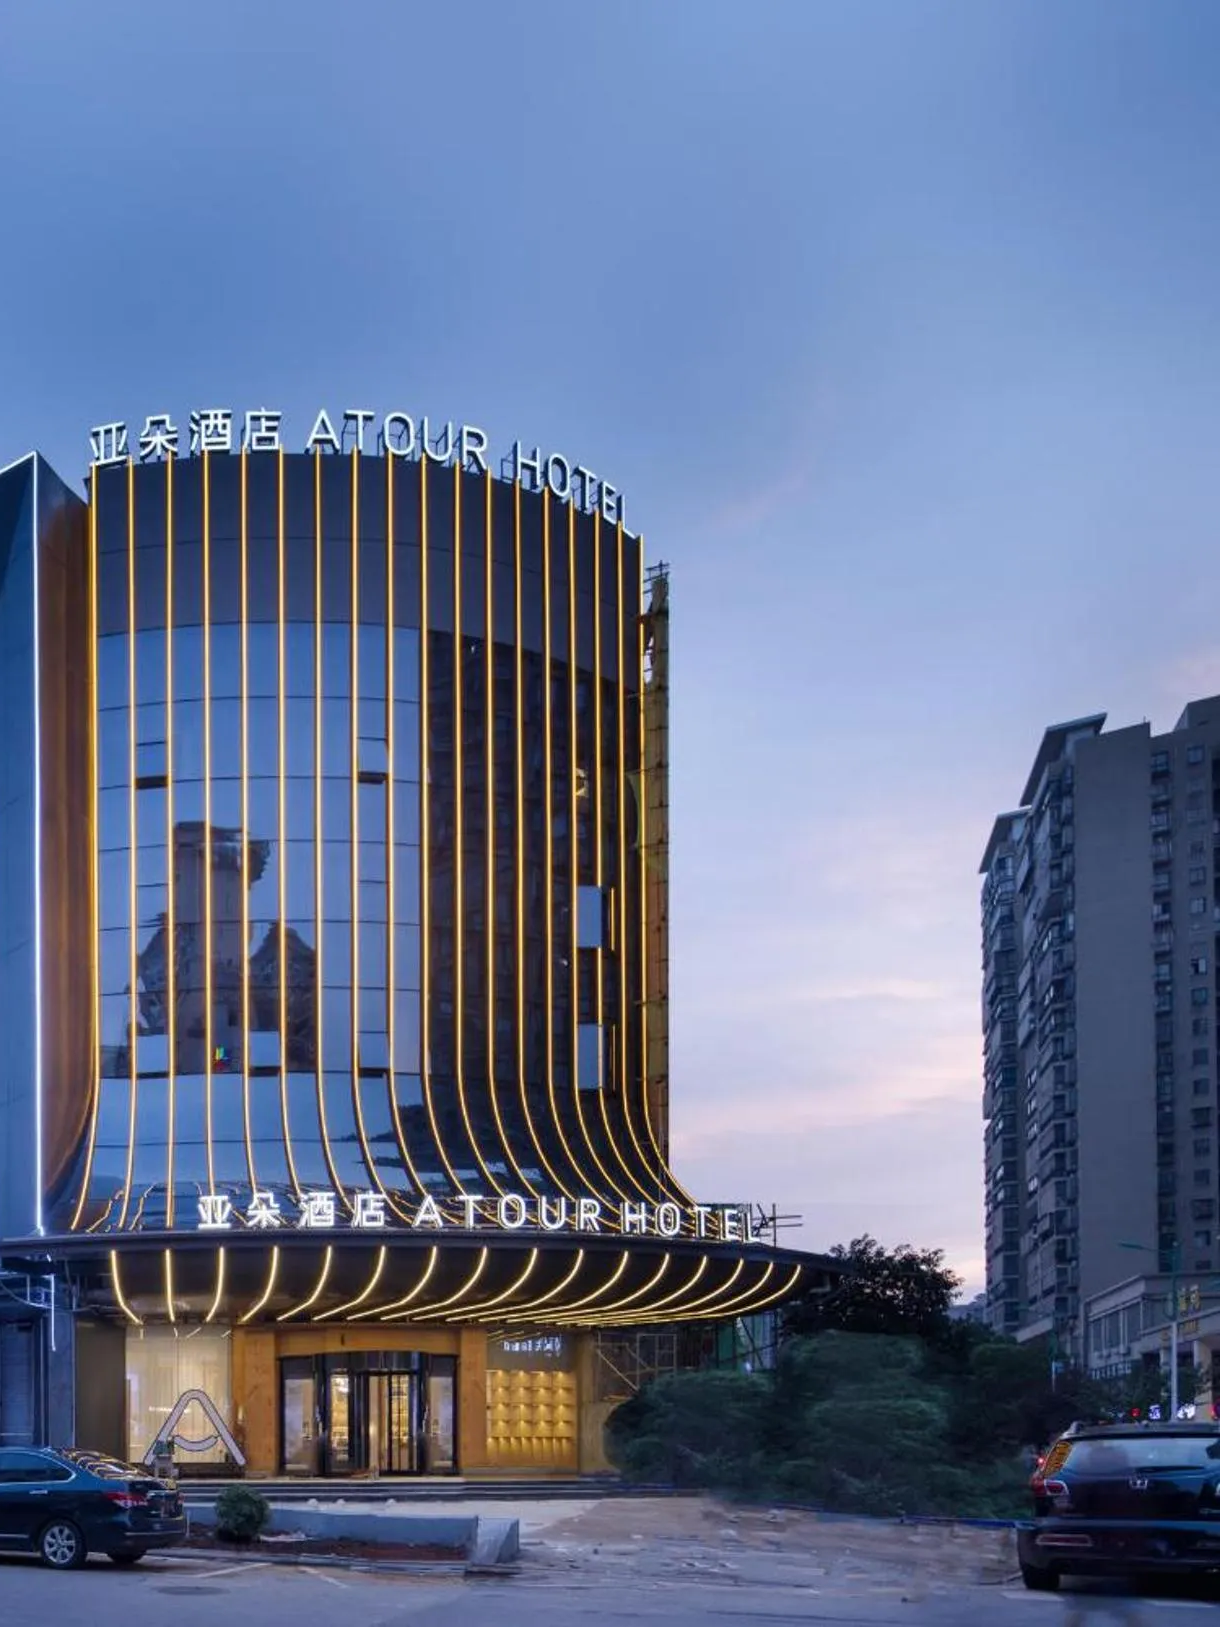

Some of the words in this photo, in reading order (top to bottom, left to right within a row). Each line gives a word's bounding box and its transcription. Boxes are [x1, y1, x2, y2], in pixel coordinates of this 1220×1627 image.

[89, 407, 282, 467] 亚朵酒店
[306, 408, 488, 470] ATOUR
[515, 439, 636, 539] HOTEL
[197, 1190, 386, 1230] 亚朵酒店
[411, 1193, 601, 1231] ATOUR
[622, 1201, 761, 1243] HOTEL
